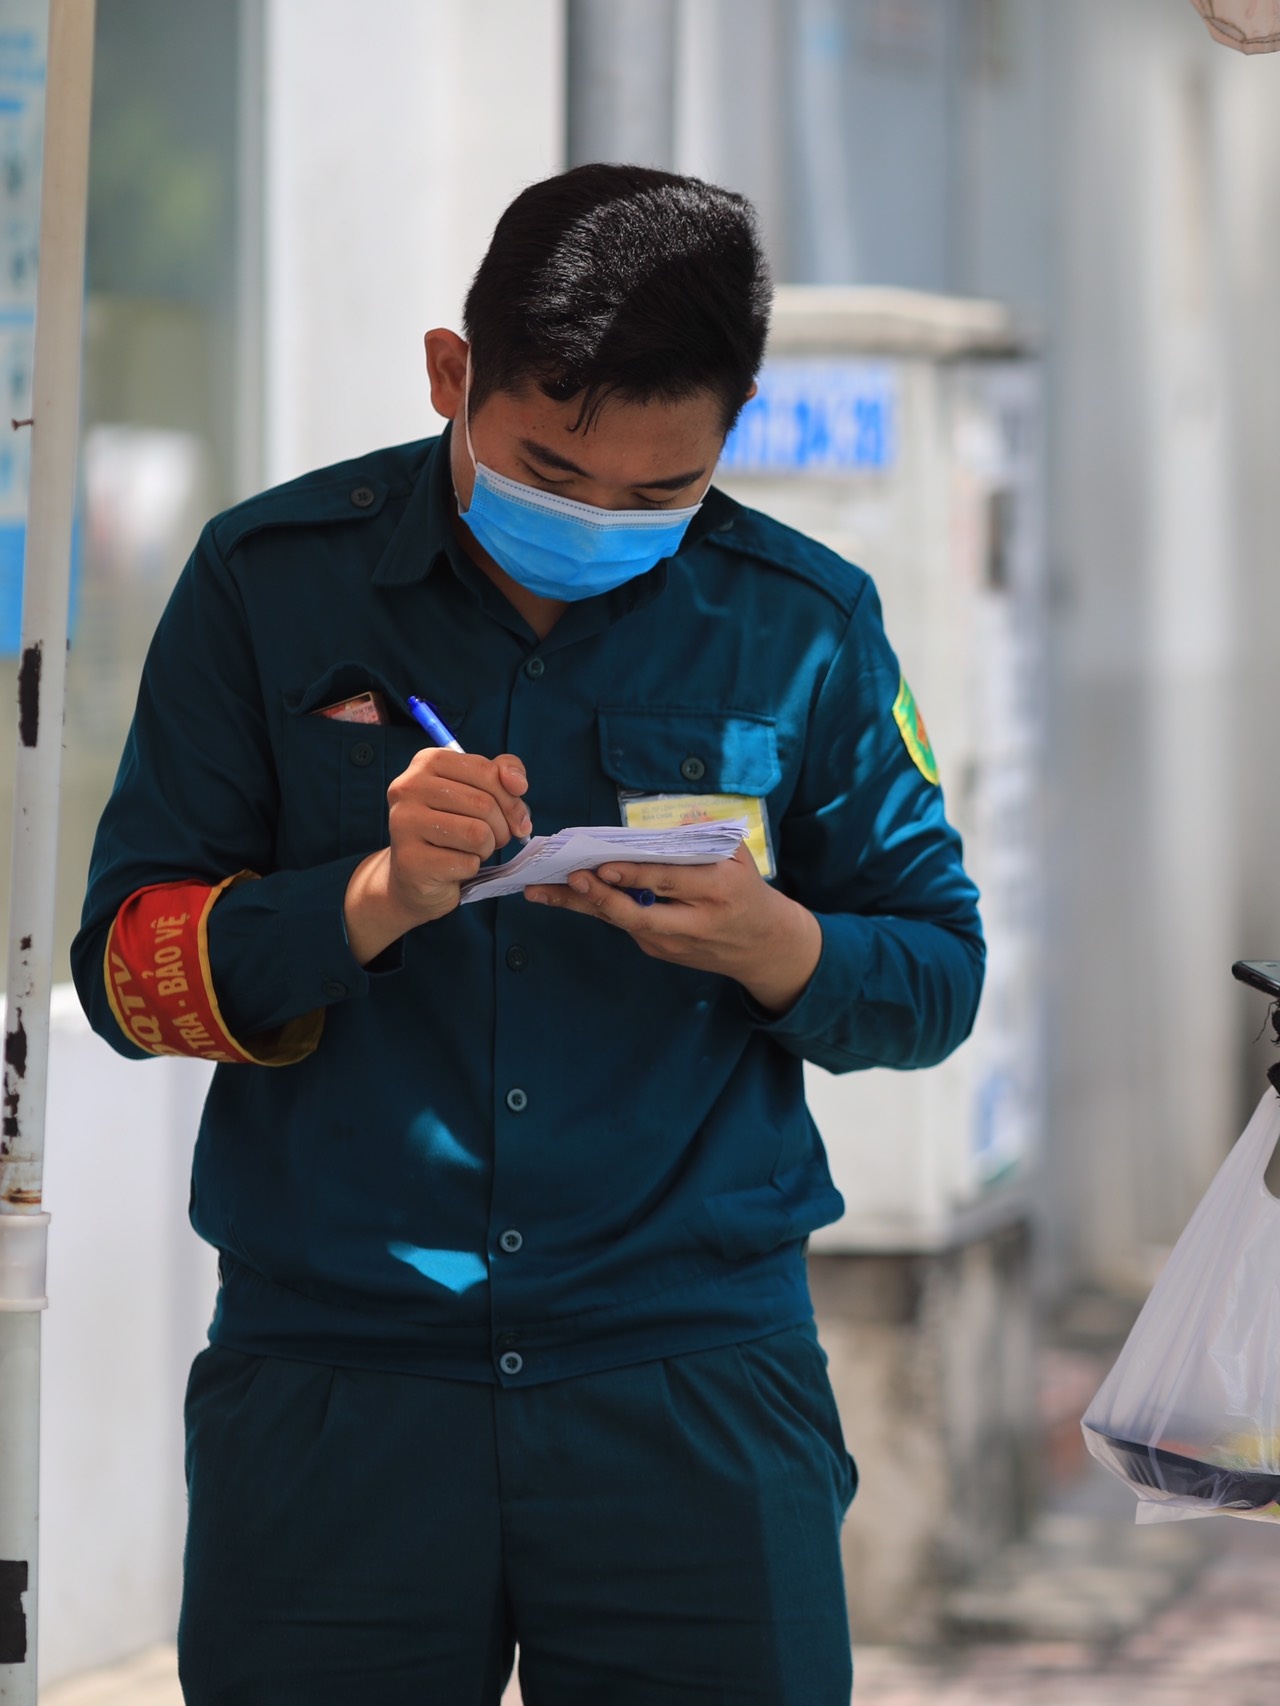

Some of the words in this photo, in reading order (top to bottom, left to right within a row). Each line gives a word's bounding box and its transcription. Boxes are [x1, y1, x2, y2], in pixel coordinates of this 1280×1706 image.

[151, 912, 190, 943] VỆ
[141, 946, 189, 997] BẢO
[172, 1012, 216, 1049] TRA
